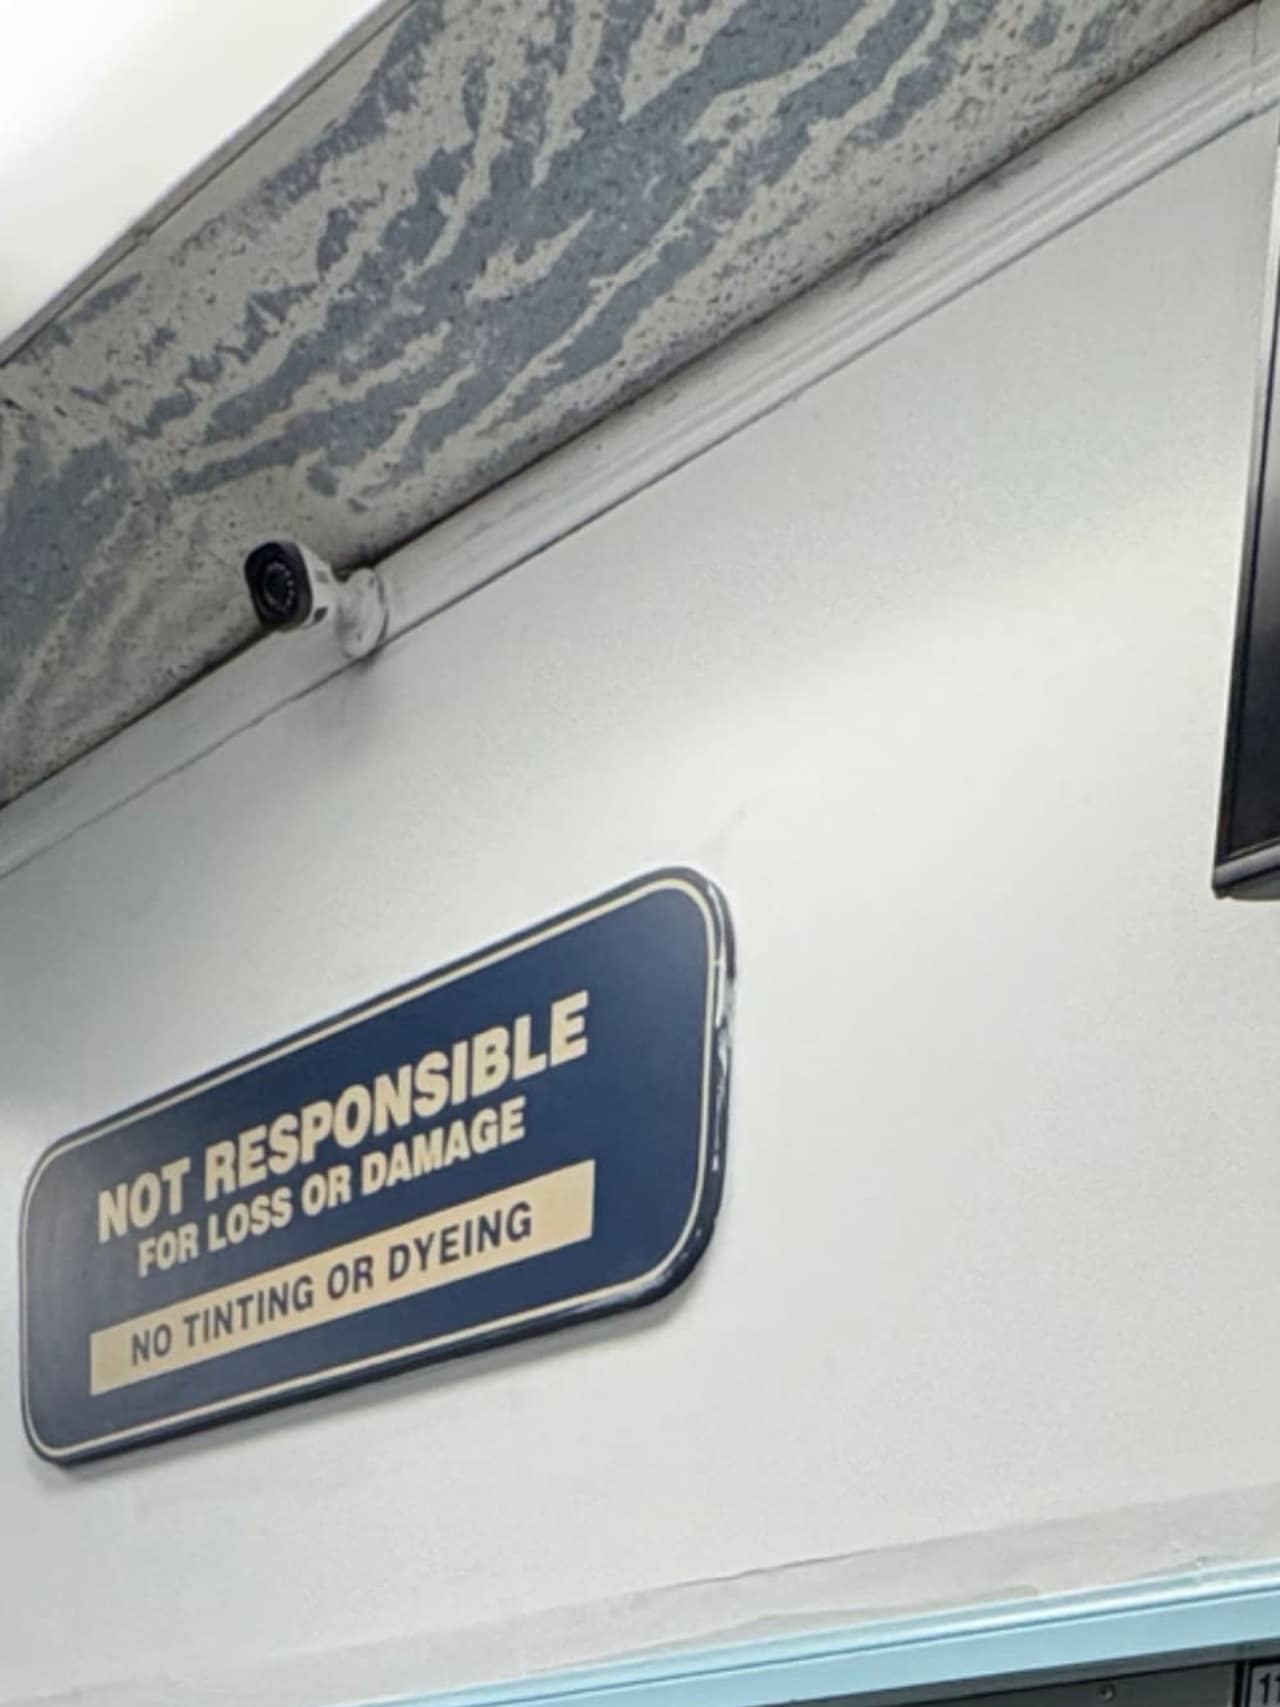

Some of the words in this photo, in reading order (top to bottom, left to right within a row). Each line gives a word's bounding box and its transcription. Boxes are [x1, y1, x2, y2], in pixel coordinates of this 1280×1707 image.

[99, 1157, 191, 1242] NOT
[204, 990, 589, 1199] RESPONSIBLE
[138, 1221, 199, 1277] FOR
[208, 1188, 292, 1251] LOSS
[301, 1165, 352, 1217] OR
[362, 1096, 525, 1196] DAMAGE
[132, 1323, 172, 1365] NO
[183, 1273, 315, 1349] TINTING
[326, 1255, 373, 1300] OR
[389, 1201, 533, 1281] DYEING
